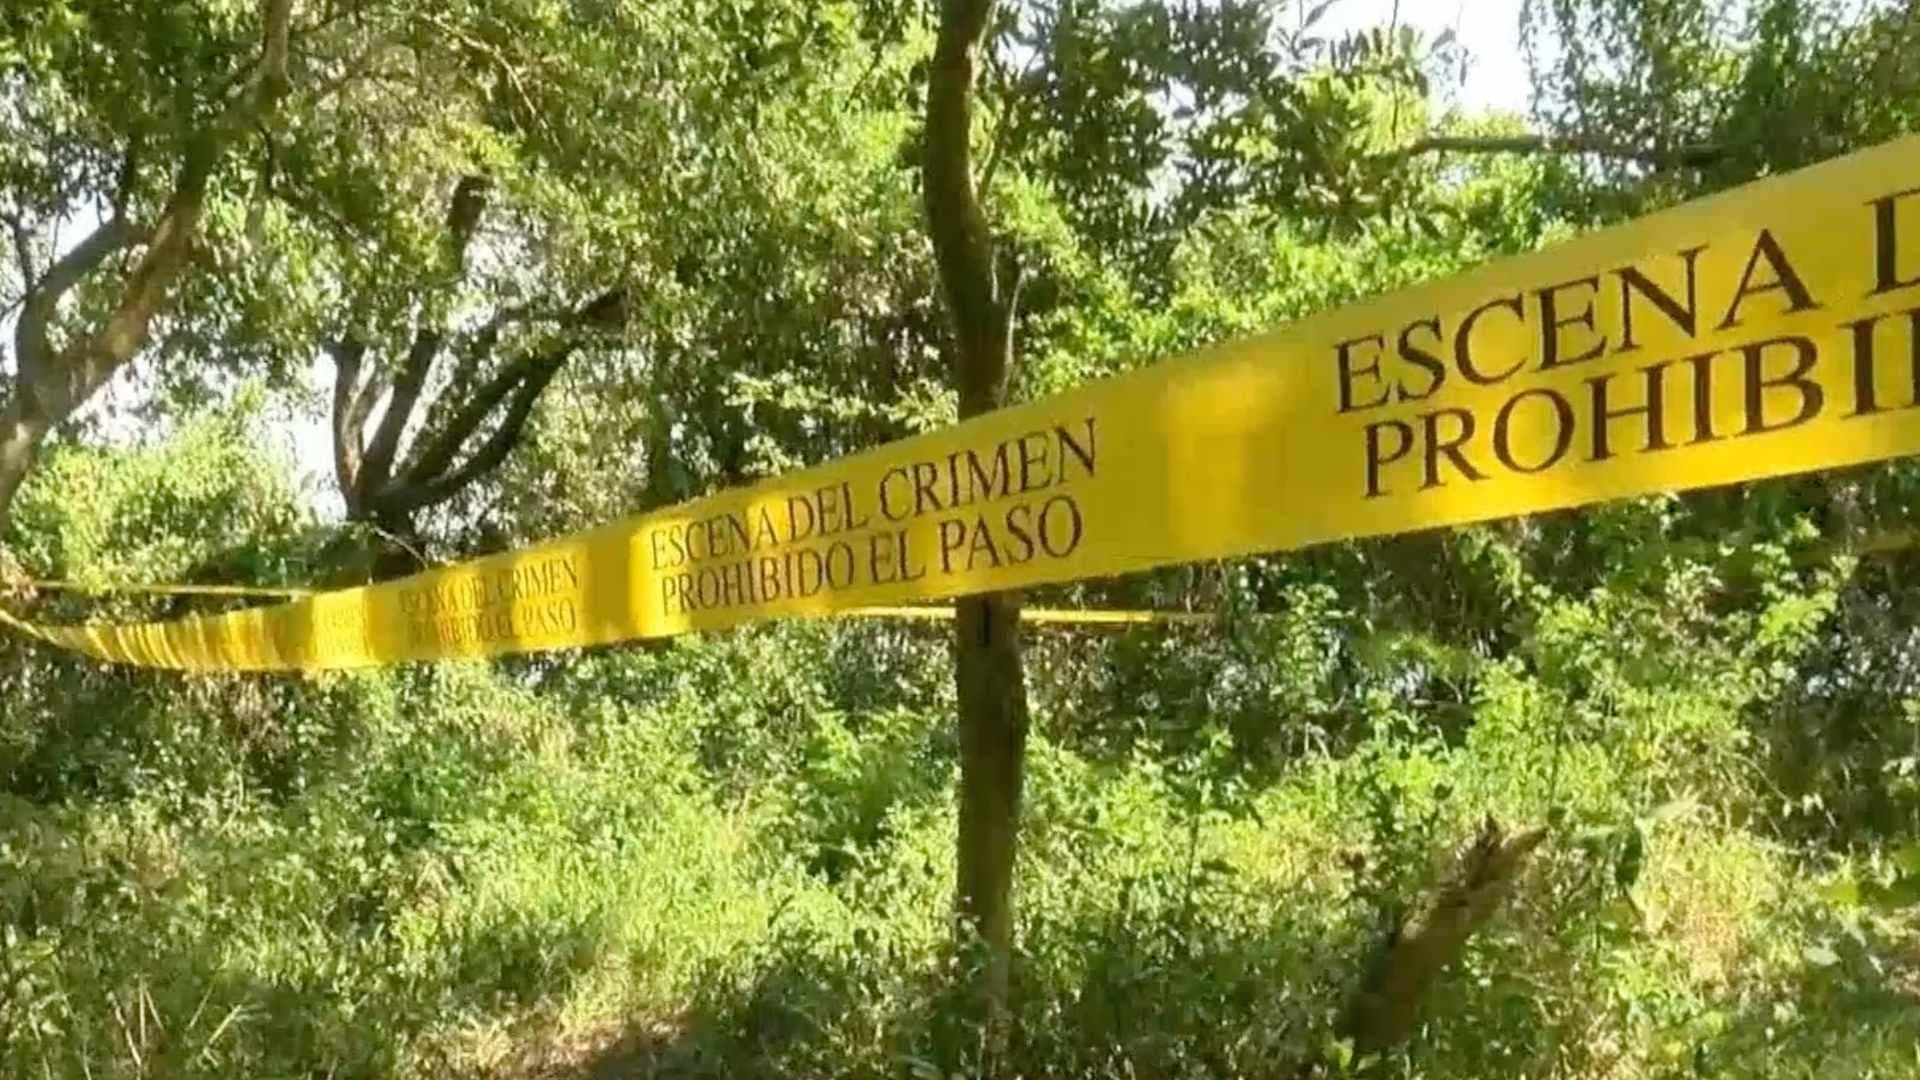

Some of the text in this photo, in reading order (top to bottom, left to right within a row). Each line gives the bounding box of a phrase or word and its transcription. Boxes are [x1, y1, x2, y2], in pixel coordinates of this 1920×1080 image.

[1334, 228, 1823, 414] ESCENA
[1364, 311, 1920, 498] PROHIBI
[651, 417, 1097, 571] ESCENA DEL CRIMEN
[661, 494, 1083, 616] PROHIBIDO EL PASO
